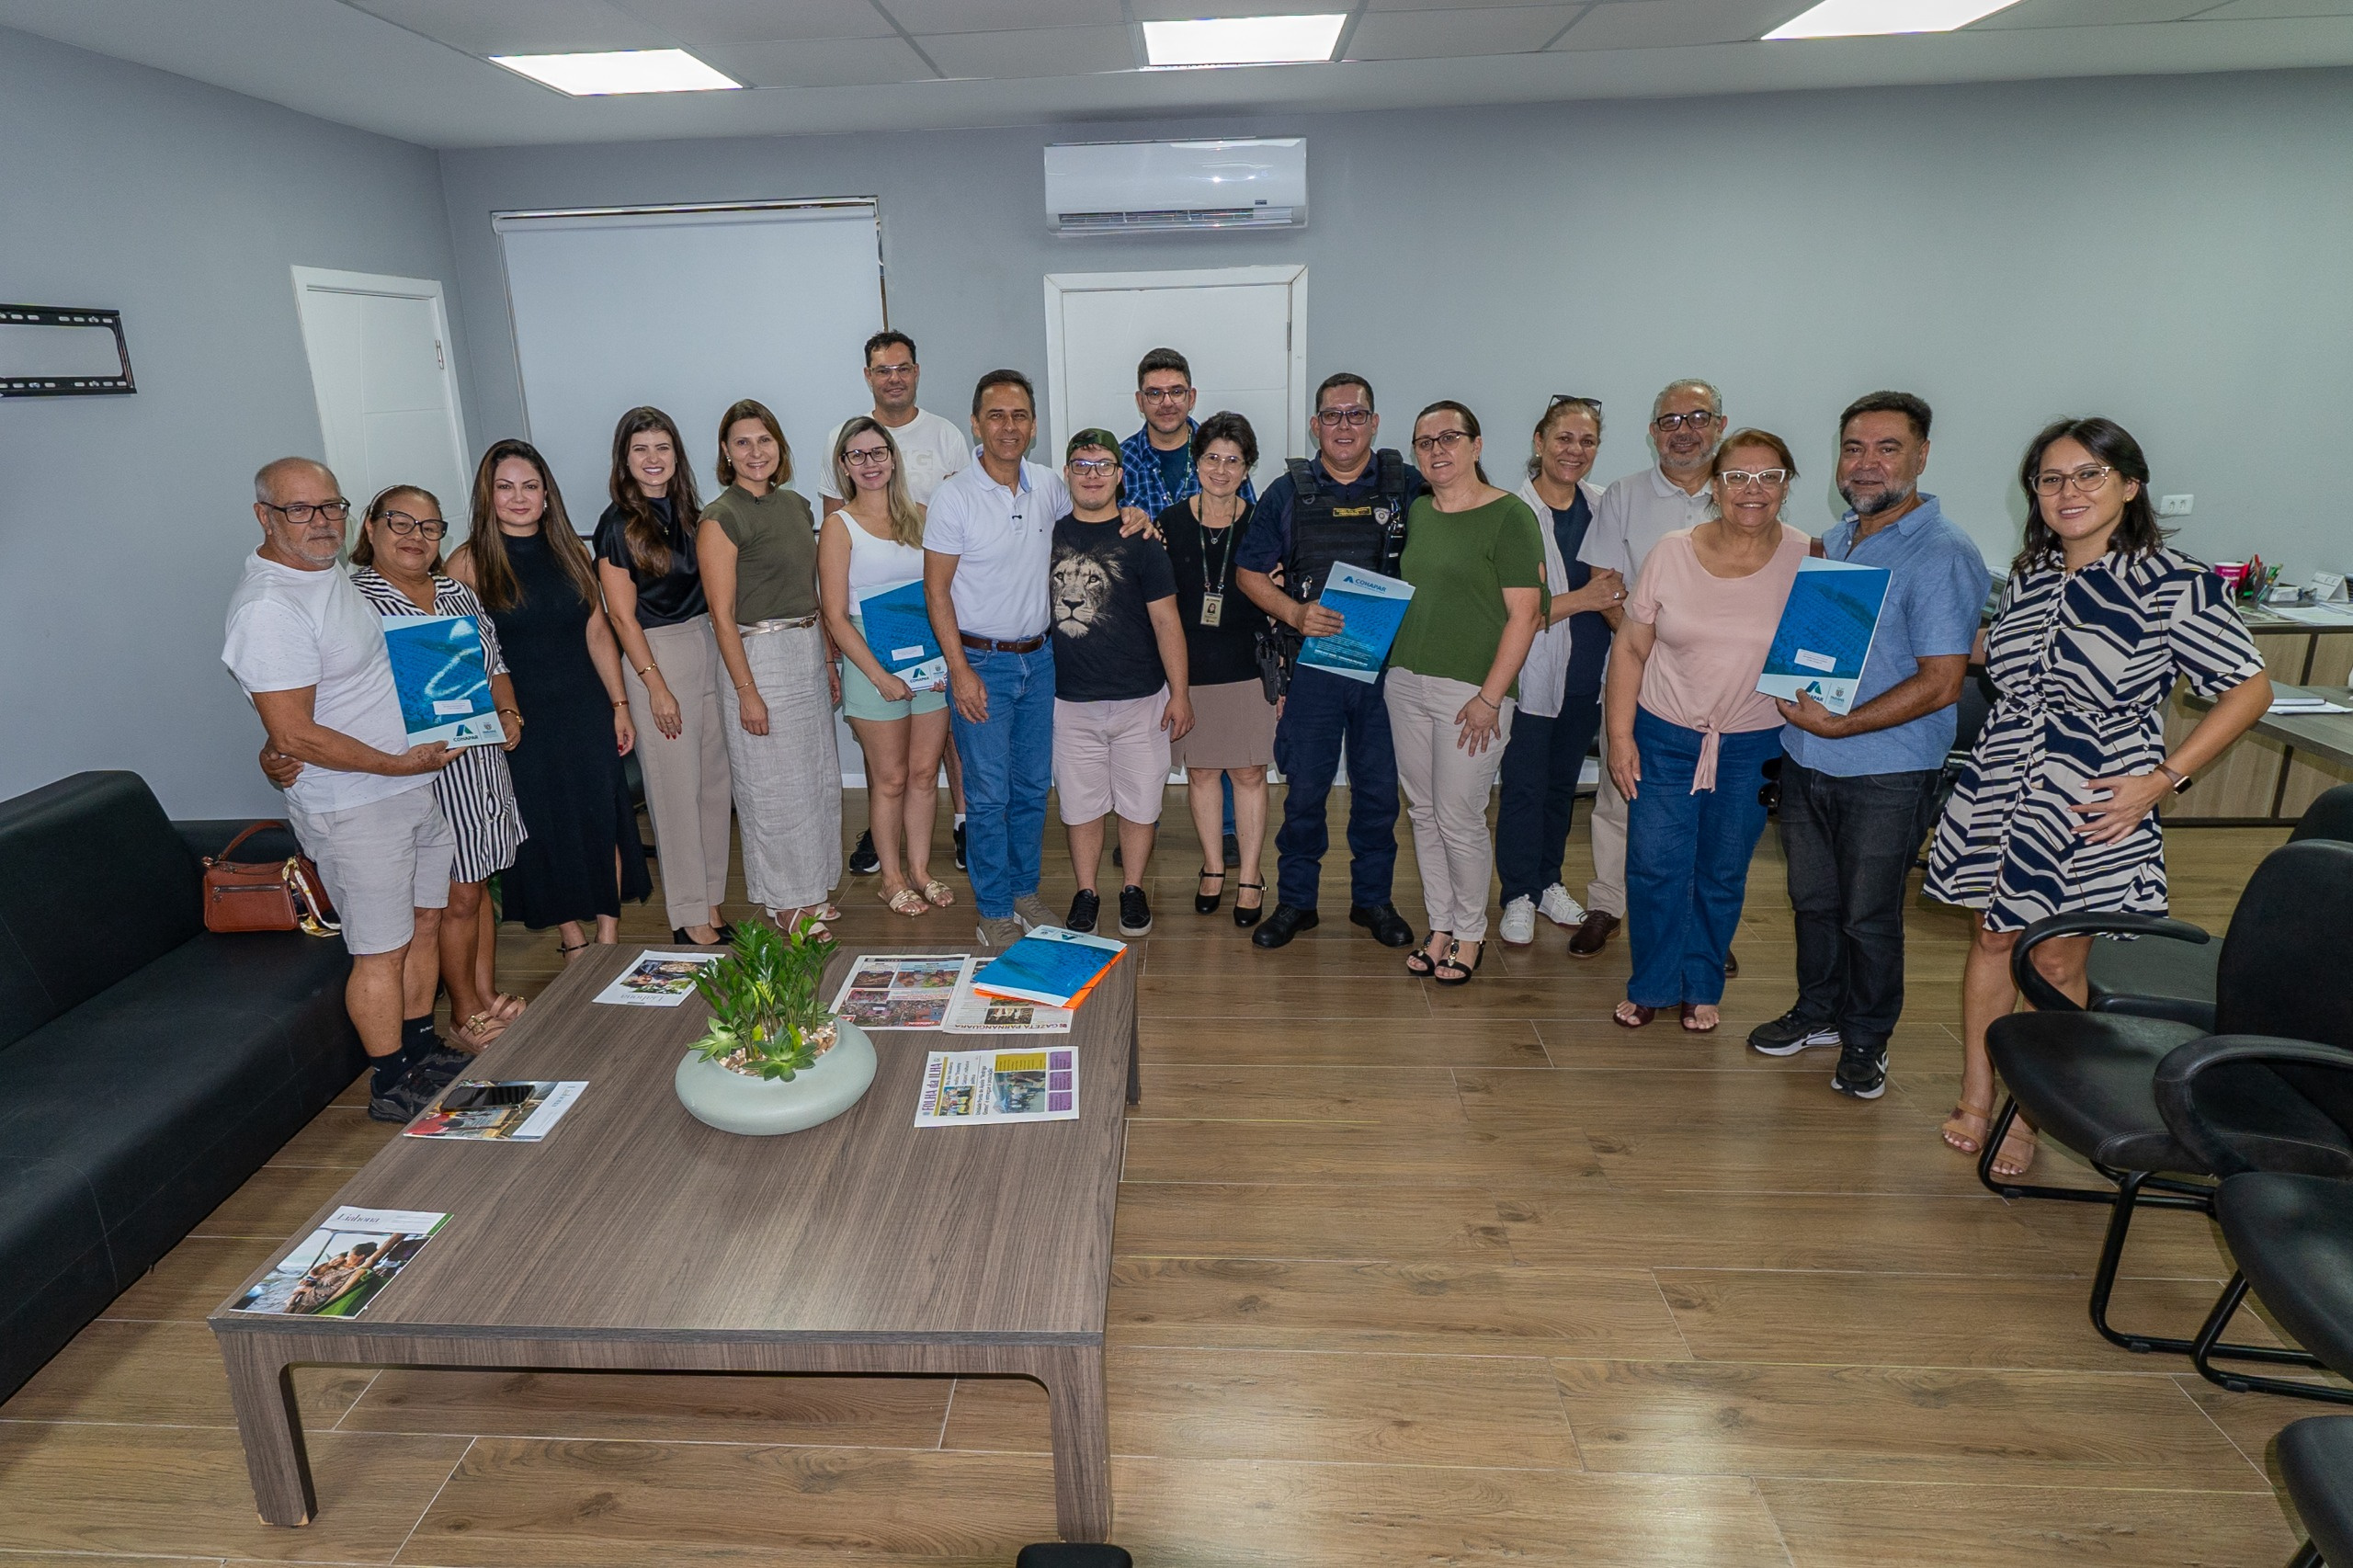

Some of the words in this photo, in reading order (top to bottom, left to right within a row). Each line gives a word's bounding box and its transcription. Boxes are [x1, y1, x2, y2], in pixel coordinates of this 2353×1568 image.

[1355, 578, 1387, 593] COHAPAR
[928, 1062, 943, 1078] ILHA
[926, 1080, 939, 1088] da
[922, 1089, 938, 1111] FOLHA
[336, 1213, 381, 1223] Liahona
